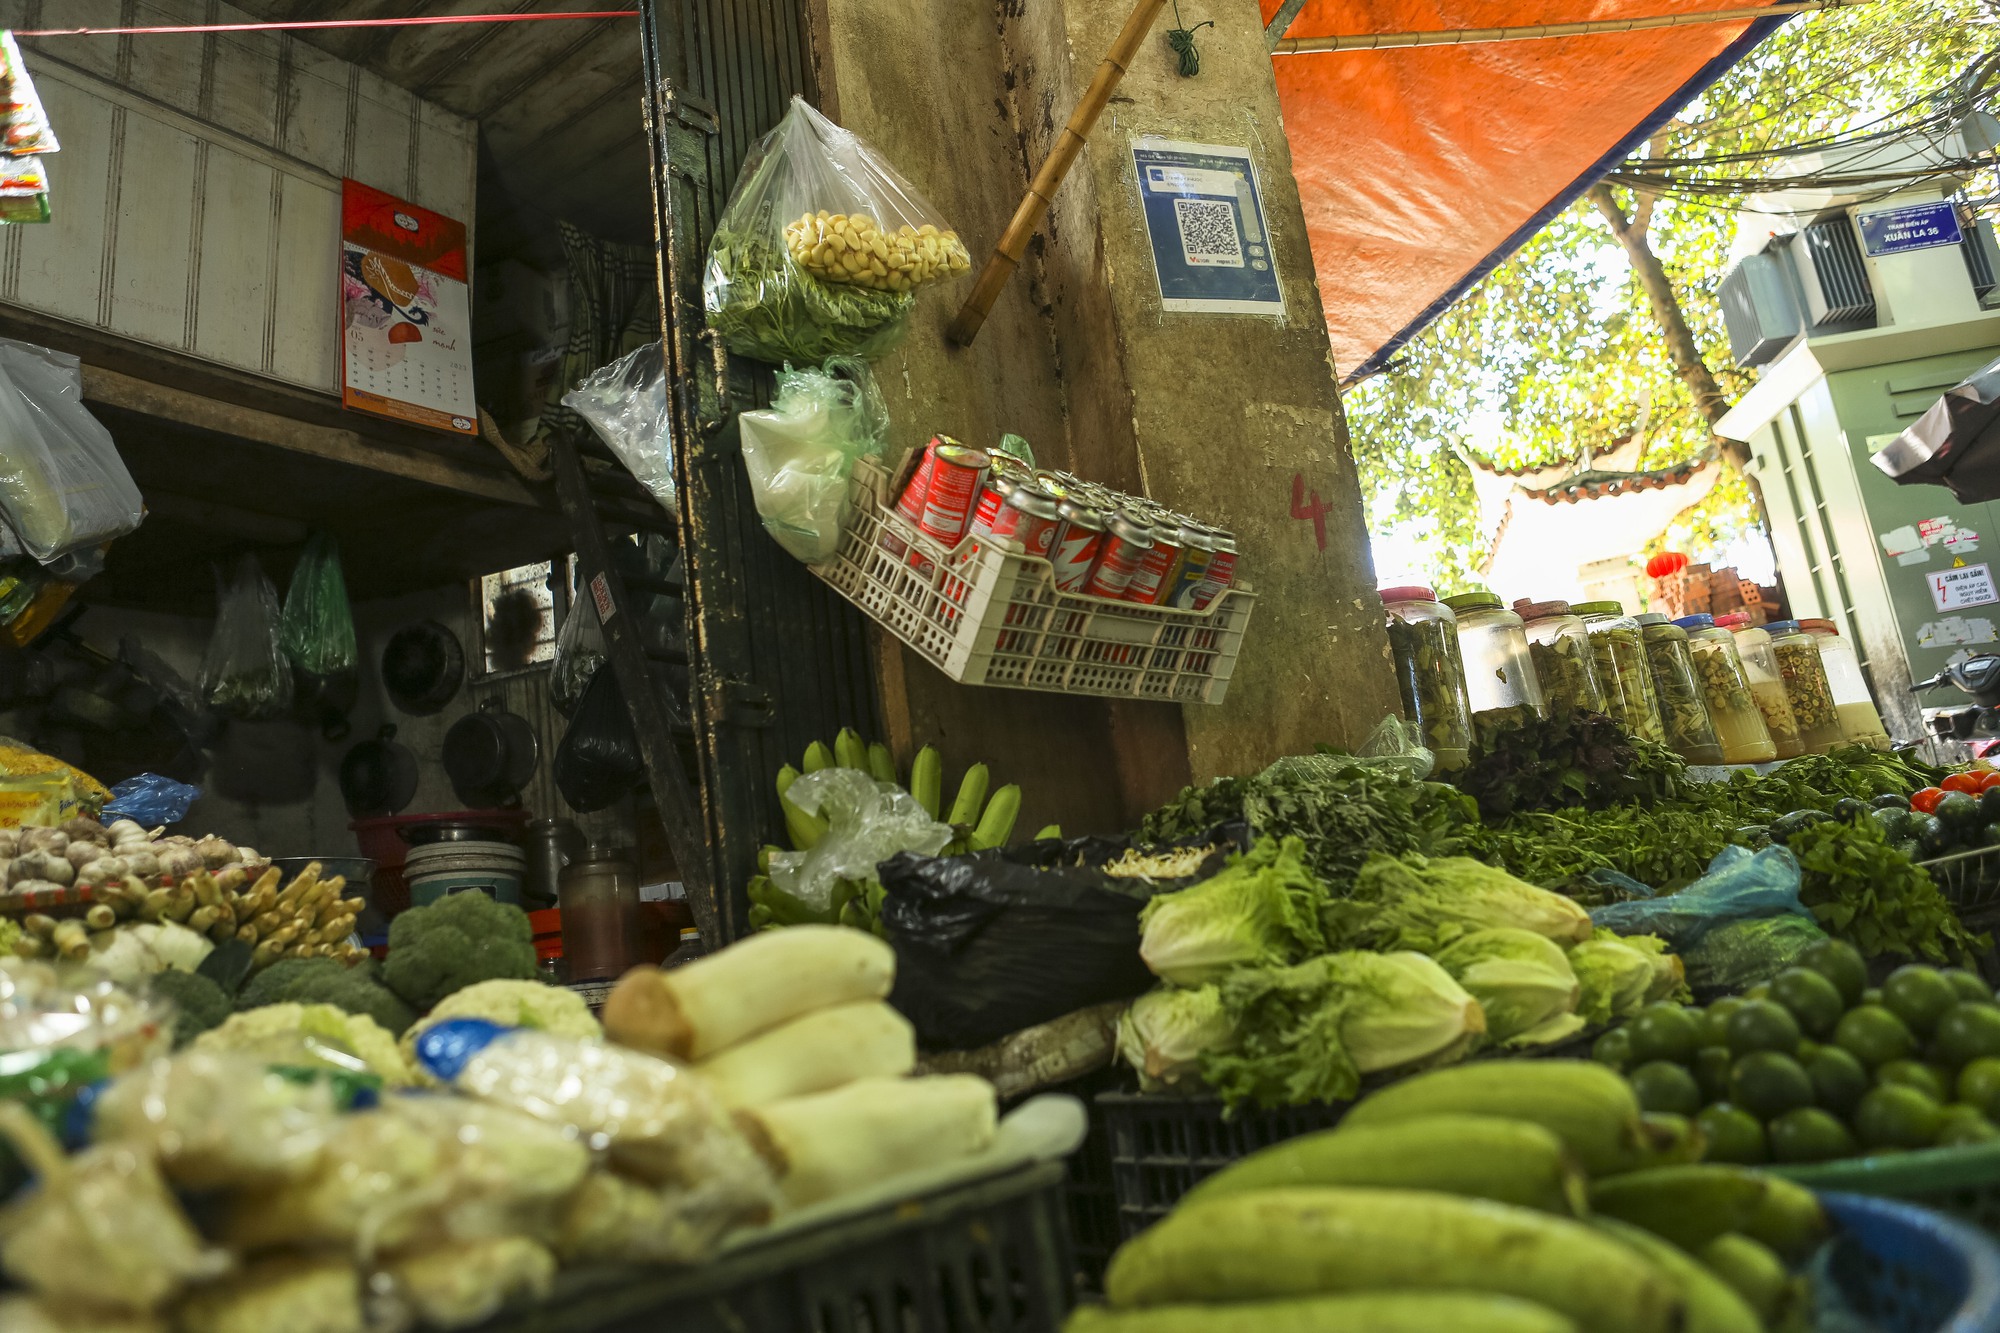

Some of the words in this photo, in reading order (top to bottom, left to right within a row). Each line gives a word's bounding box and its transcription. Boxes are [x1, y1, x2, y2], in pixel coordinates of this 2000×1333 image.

[1884, 230, 1911, 242] XUÂN
[1912, 229, 1926, 238] LA
[1291, 472, 1332, 552] 4
